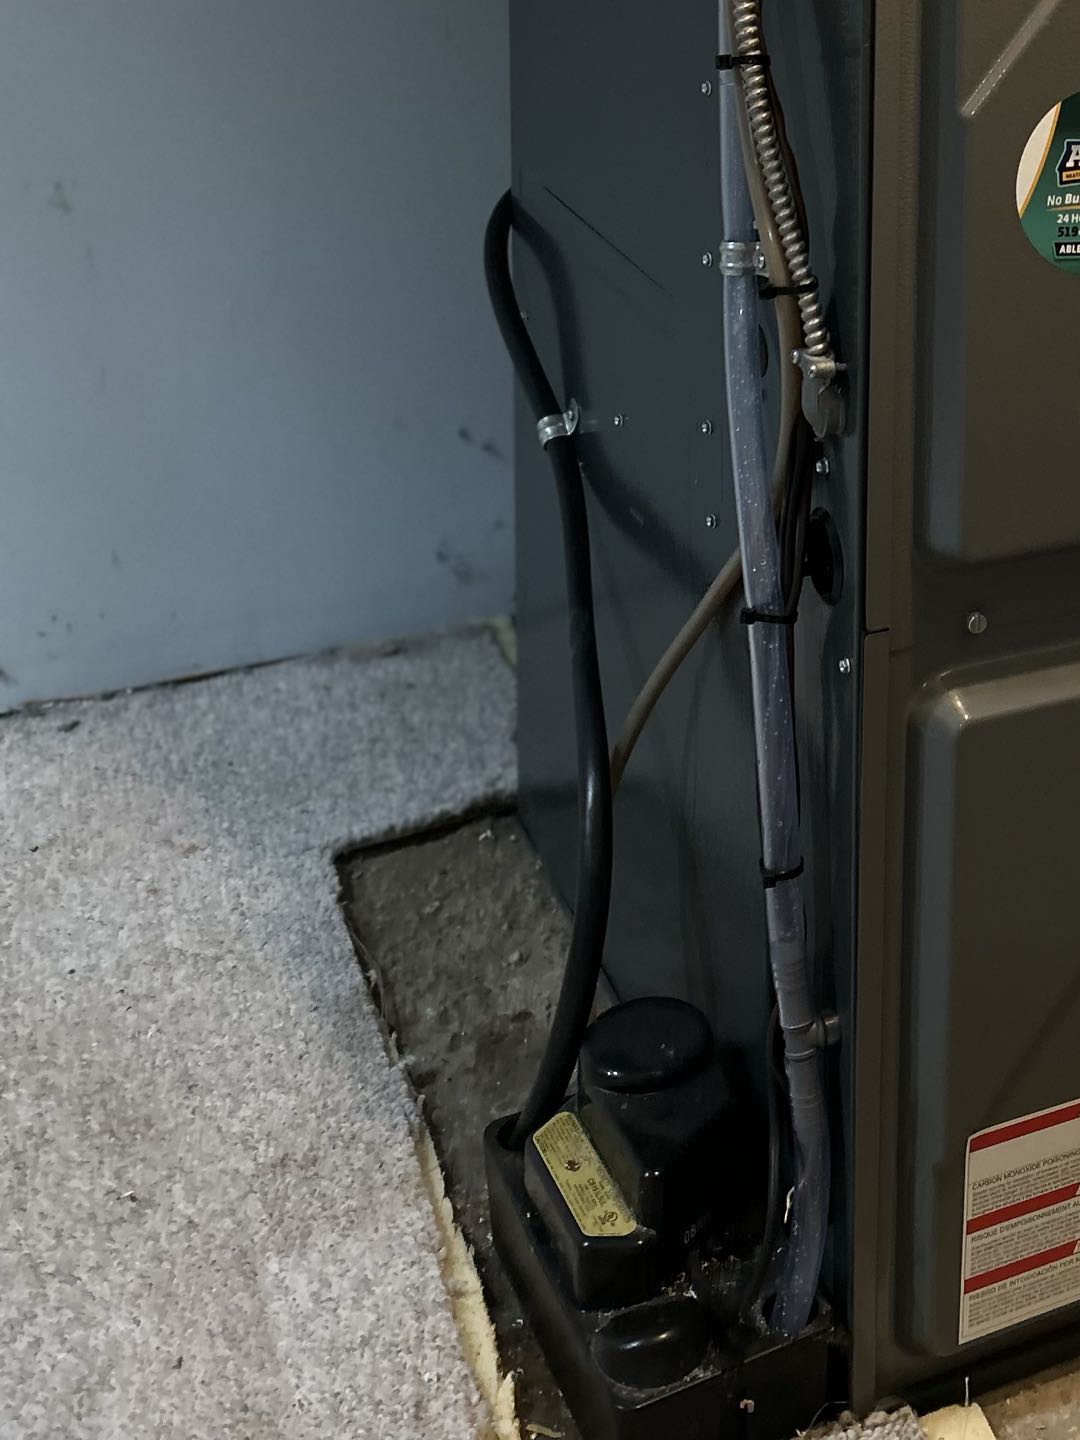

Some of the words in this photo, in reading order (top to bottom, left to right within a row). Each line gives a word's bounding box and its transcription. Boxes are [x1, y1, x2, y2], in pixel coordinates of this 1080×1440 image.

[1047, 195, 1062, 206] No
[1057, 214, 1070, 224] 24
[972, 1176, 1002, 1190] CARBON
[1003, 1162, 1041, 1179] MONOXIDE
